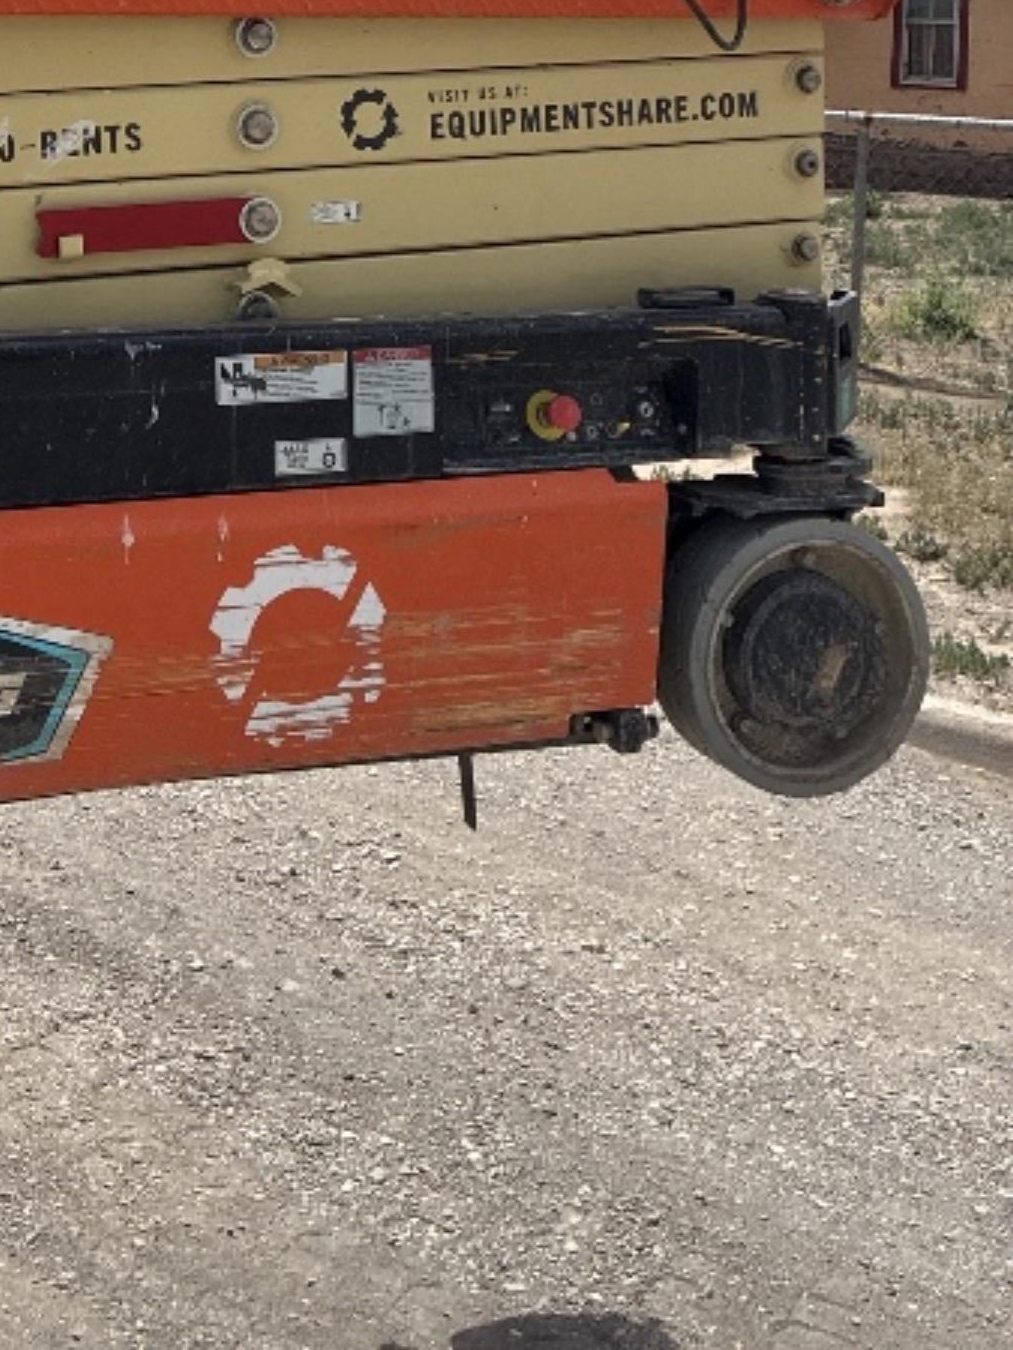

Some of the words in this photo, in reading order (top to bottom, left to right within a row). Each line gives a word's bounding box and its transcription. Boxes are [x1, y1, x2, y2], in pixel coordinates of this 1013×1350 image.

[427, 88, 470, 103] VISIT
[478, 86, 497, 101] US
[503, 84, 529, 100] AT:
[430, 90, 759, 140] EQUIPMENTSHARE.COM
